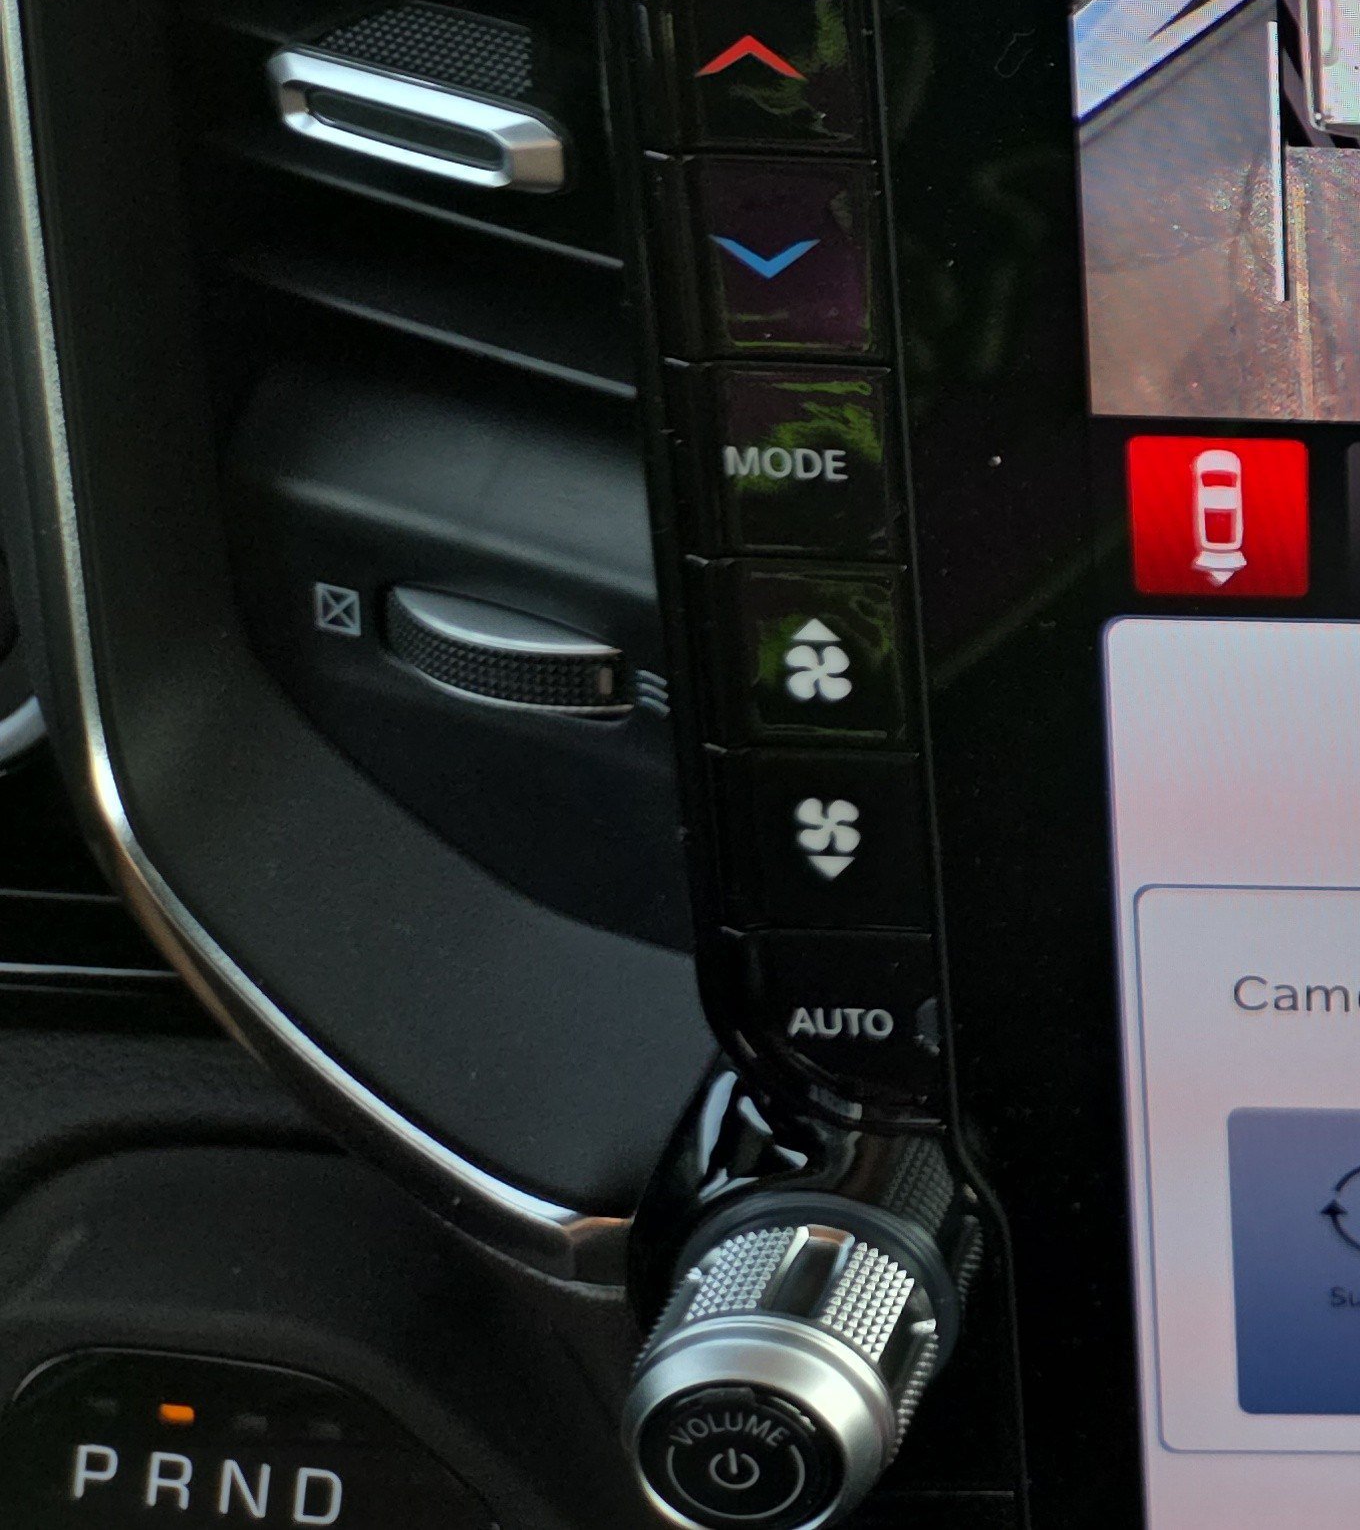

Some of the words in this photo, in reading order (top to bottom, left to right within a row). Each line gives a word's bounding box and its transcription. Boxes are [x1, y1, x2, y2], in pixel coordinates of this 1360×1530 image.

[723, 445, 849, 483] MODE
[787, 1006, 894, 1040] AUTO
[669, 1411, 791, 1448] VOLUME
